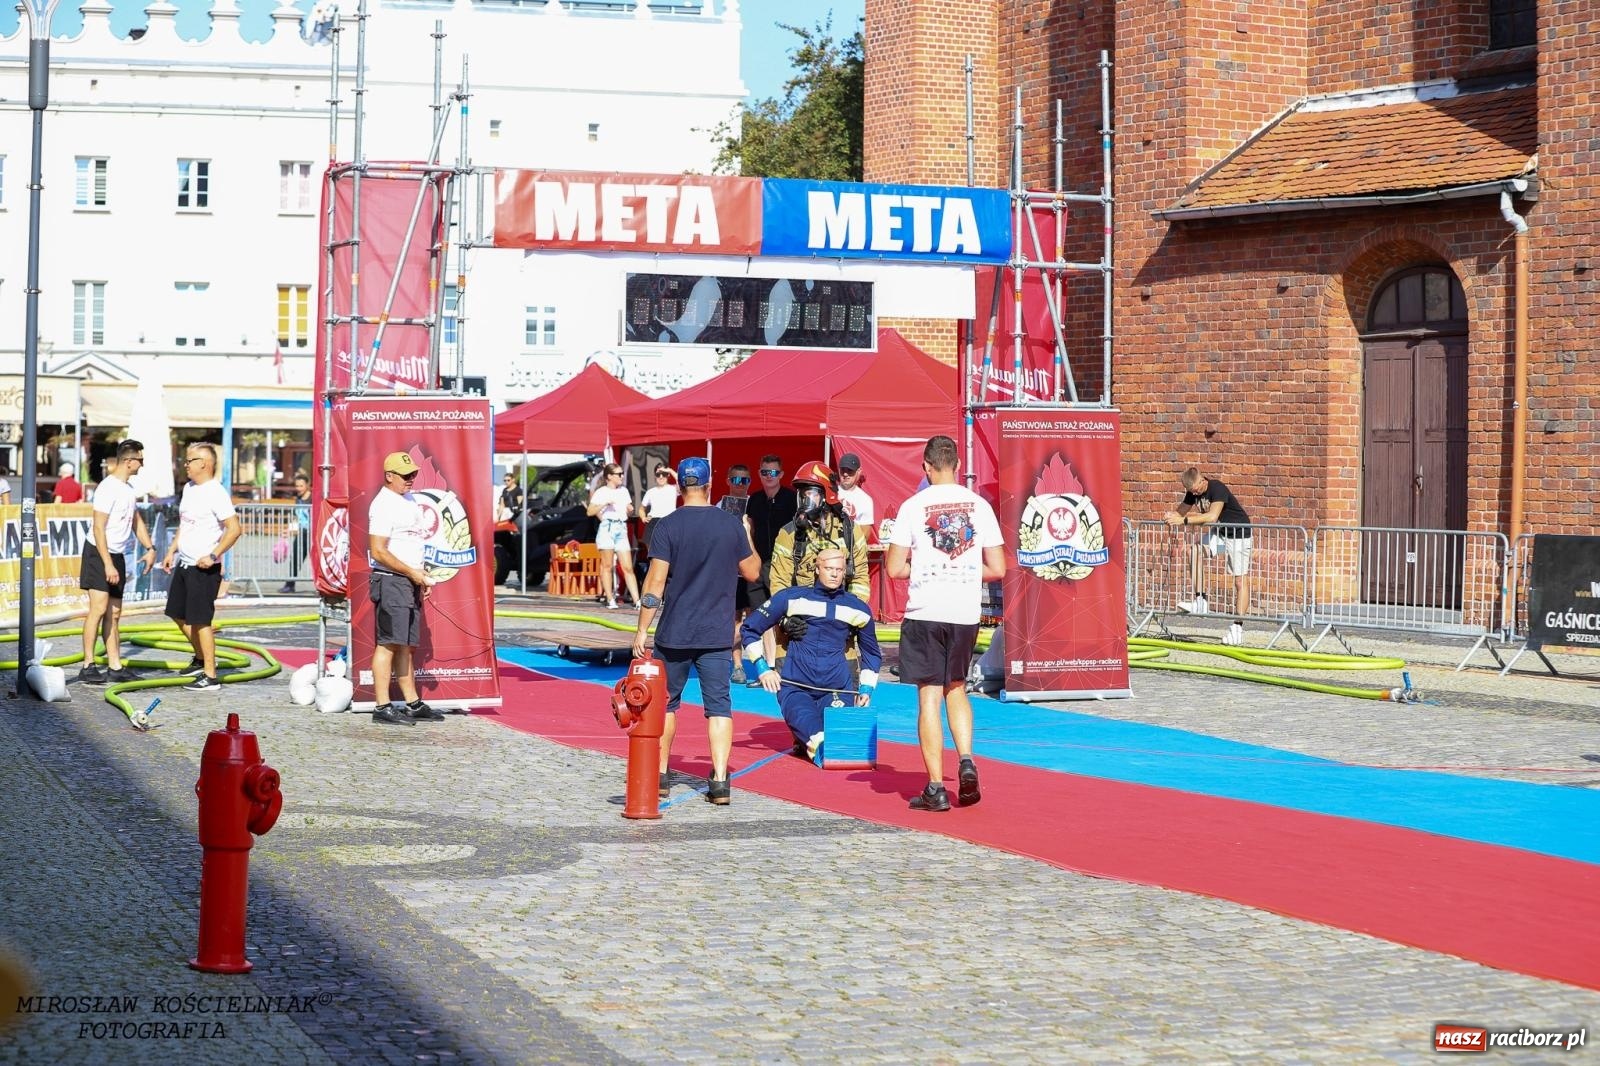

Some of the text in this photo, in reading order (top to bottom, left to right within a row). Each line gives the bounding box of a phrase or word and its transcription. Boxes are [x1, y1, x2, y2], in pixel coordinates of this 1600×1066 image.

[534, 181, 721, 246] META
[807, 191, 982, 255] META
[352, 410, 485, 421] PAŃSTWOWA STRAŻ POŻARNA
[1002, 419, 1114, 430] PAŃSTWOWA STRAŻ POŻARNA
[437, 553, 473, 564] POŻARNA
[1545, 607, 1600, 631] GAŚNICE
[1566, 632, 1600, 643] SPRZEDA
